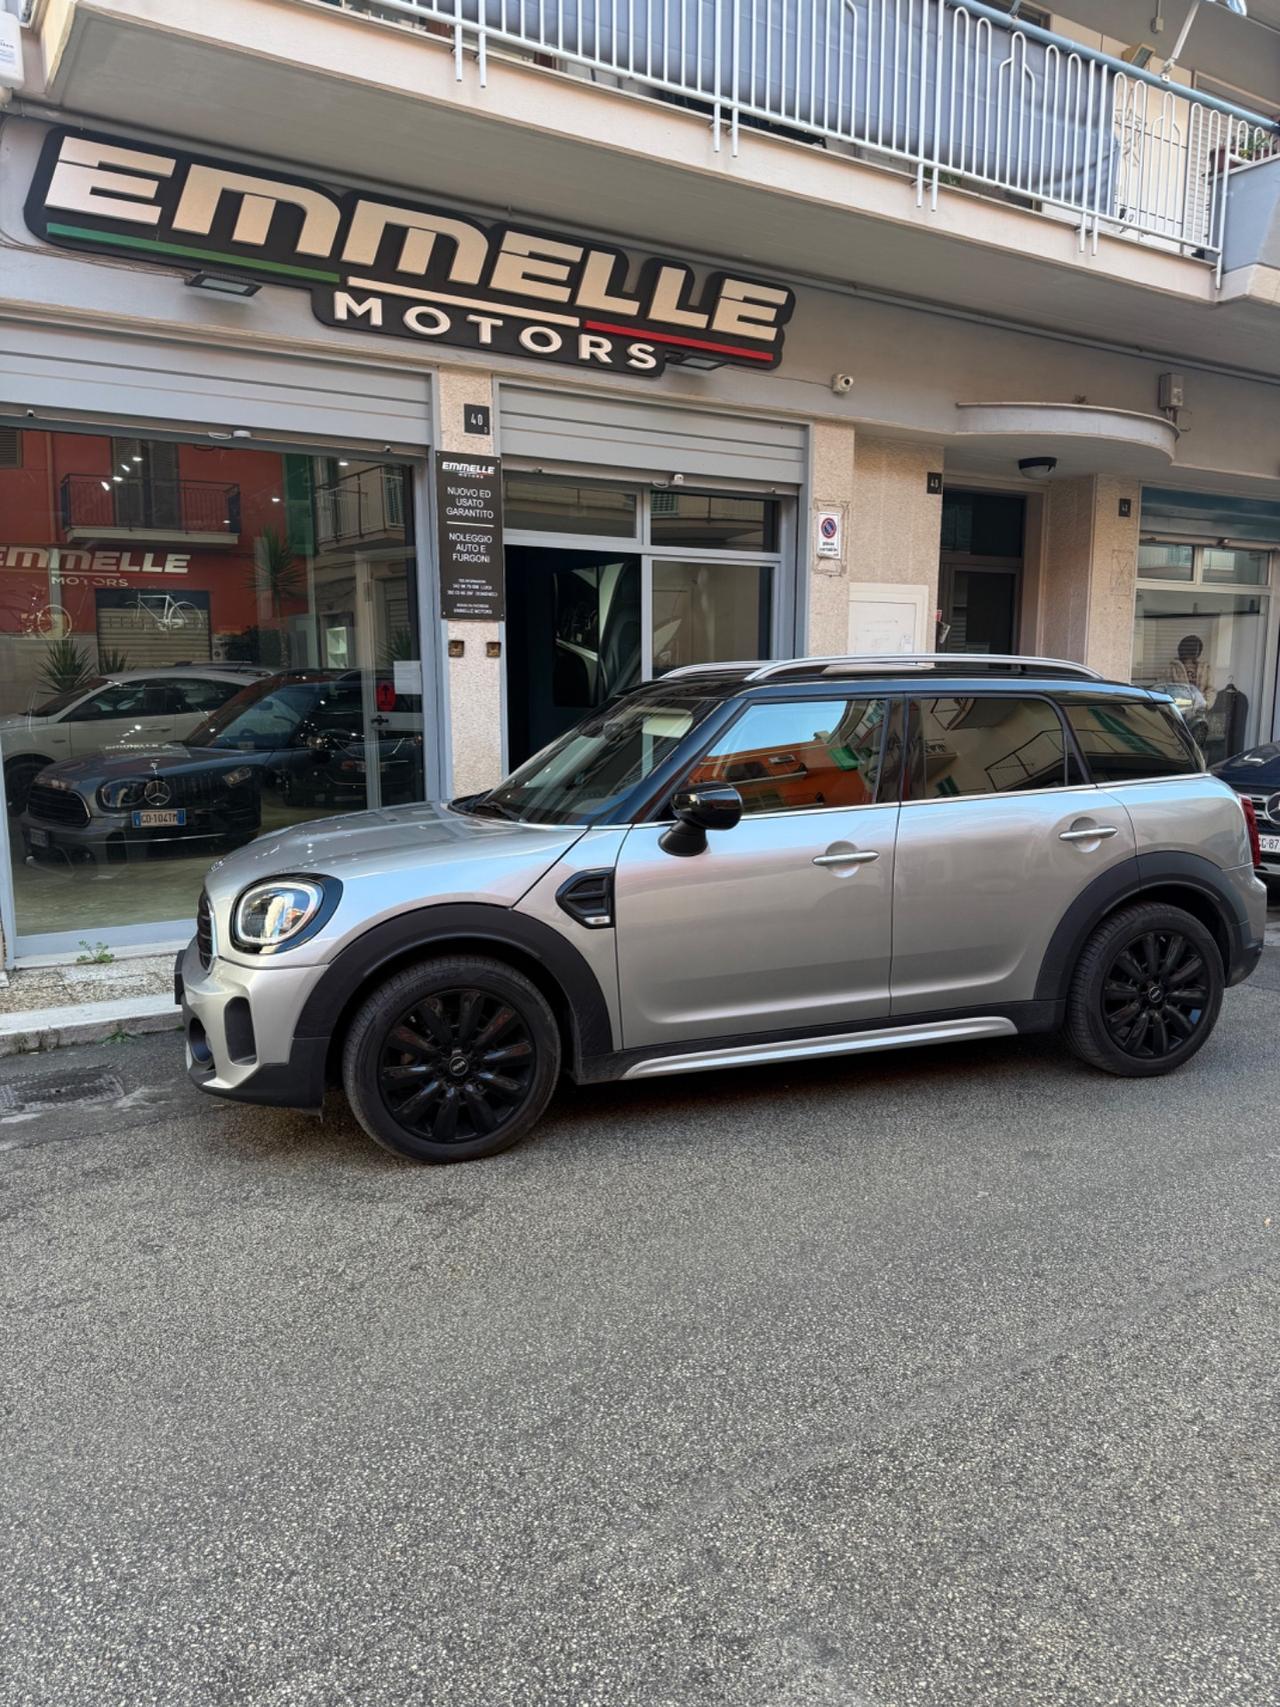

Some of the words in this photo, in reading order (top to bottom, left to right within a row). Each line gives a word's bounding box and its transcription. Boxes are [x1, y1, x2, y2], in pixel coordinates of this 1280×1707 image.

[44, 135, 789, 342] EMMELLE
[334, 291, 659, 370] MOTORS
[470, 413, 484, 426] 40
[442, 461, 495, 475] EMMELLE
[447, 486, 478, 497] NUOVO
[479, 489, 491, 498] ED
[456, 497, 484, 508] USATO
[446, 506, 494, 519] GARANTITO
[449, 532, 493, 543] NOLEGGIO
[455, 543, 479, 552] AUTO
[480, 545, 486, 553] E
[0, 545, 192, 574] MMELLE
[452, 553, 490, 563] FURGONI
